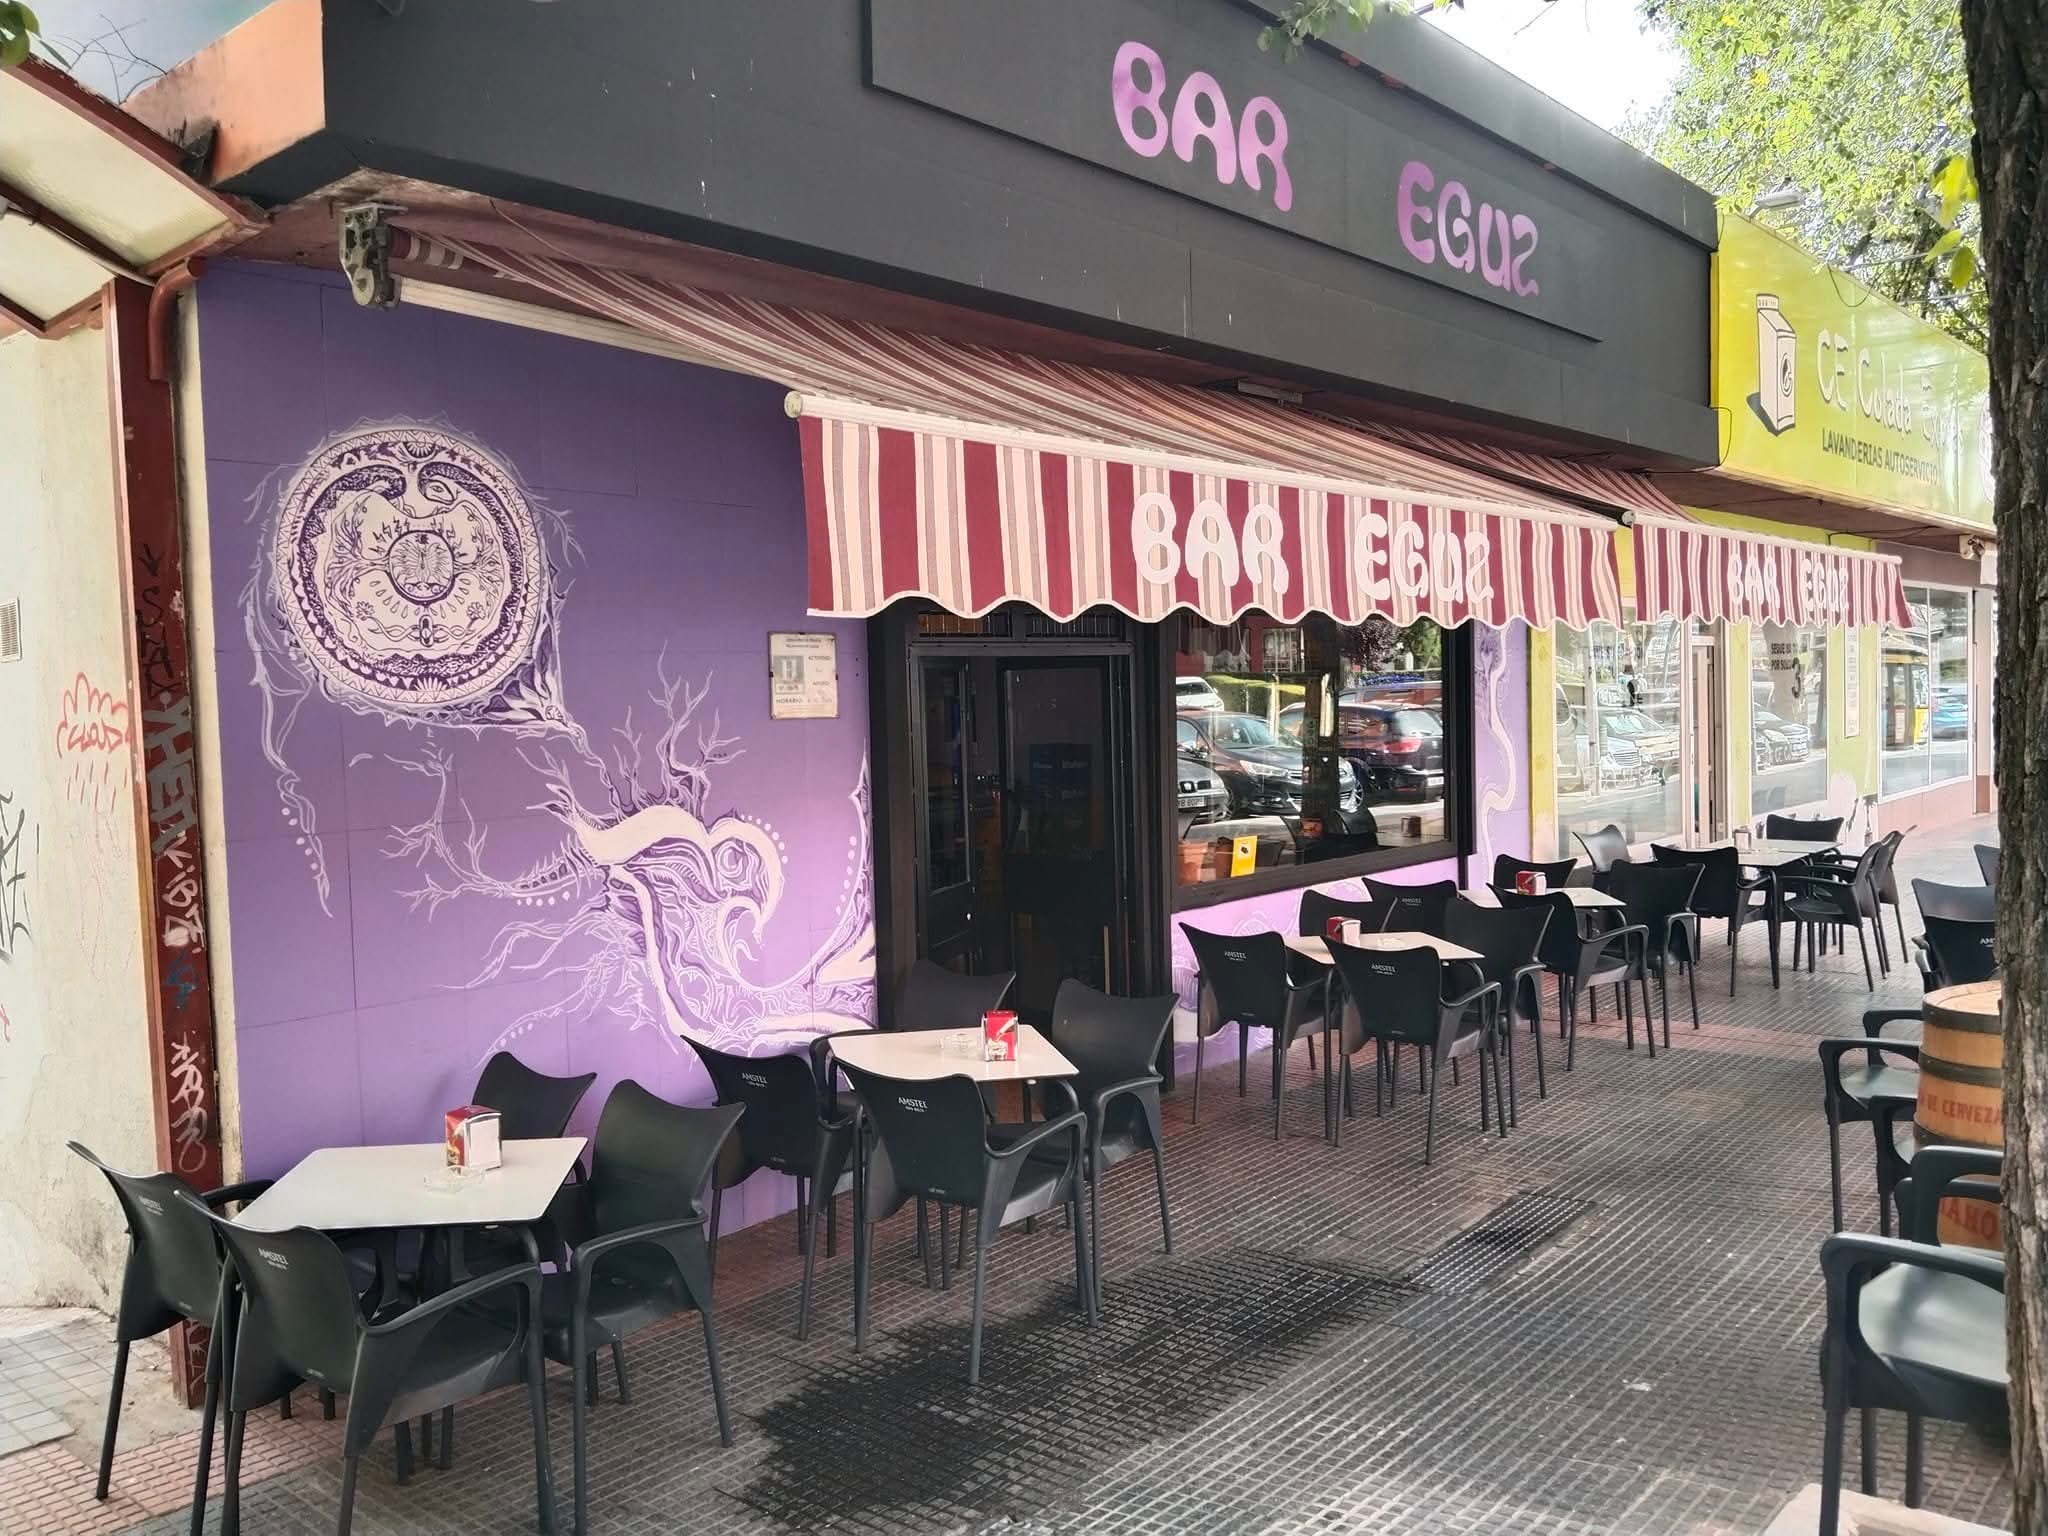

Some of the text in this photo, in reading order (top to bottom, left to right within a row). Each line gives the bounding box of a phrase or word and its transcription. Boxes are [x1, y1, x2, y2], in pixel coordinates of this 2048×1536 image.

[1112, 40, 1294, 212] BAR
[1822, 428, 1938, 486] LAVANDERIAS AUTOSERVICIO
[1131, 492, 1290, 595] BAR
[1727, 553, 1781, 609] BAR
[898, 1096, 928, 1109] AMSTEL
